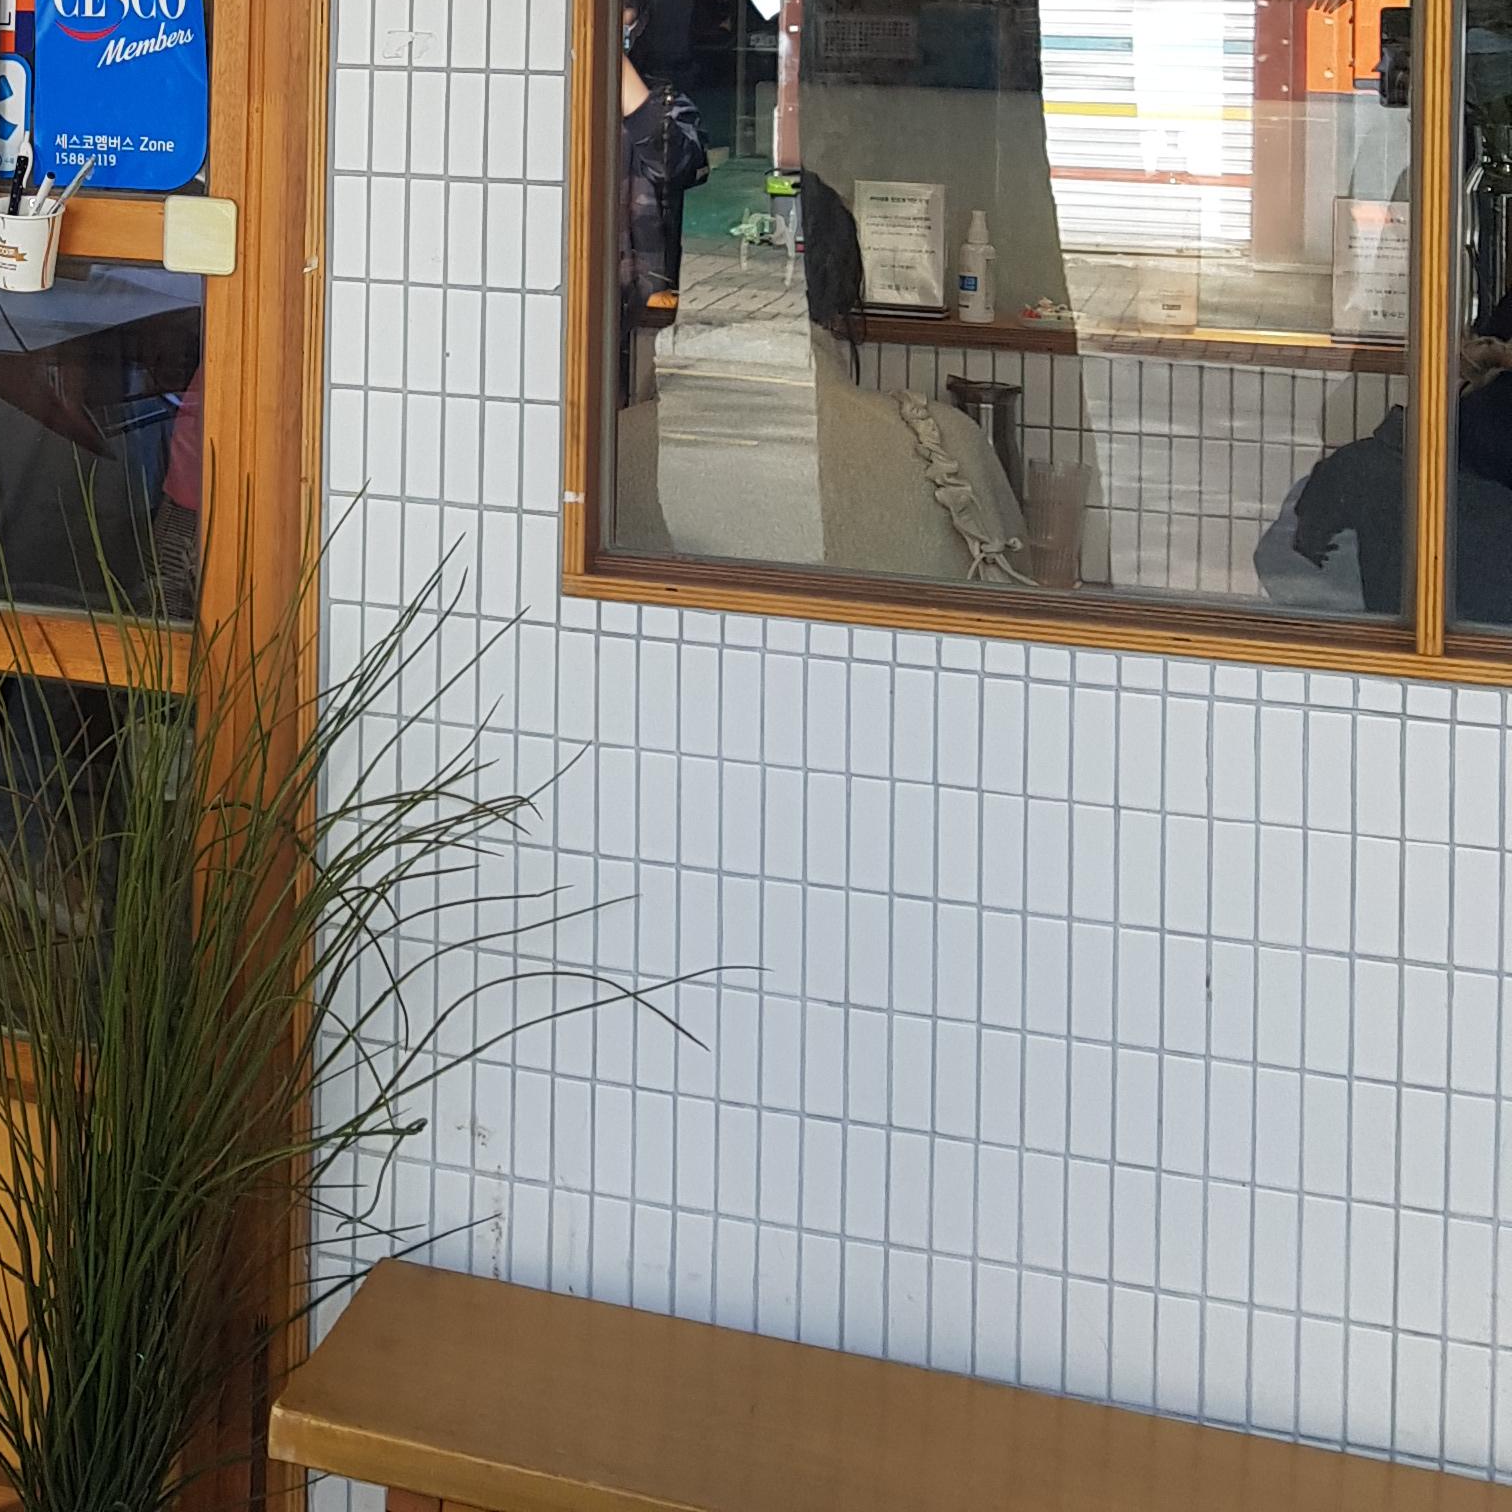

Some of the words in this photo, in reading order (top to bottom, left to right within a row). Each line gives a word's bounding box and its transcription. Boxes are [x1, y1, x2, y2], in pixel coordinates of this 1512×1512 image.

[97, 22, 194, 69] Members
[55, 133, 135, 153] 세스코엠버스
[139, 135, 175, 153] Zone
